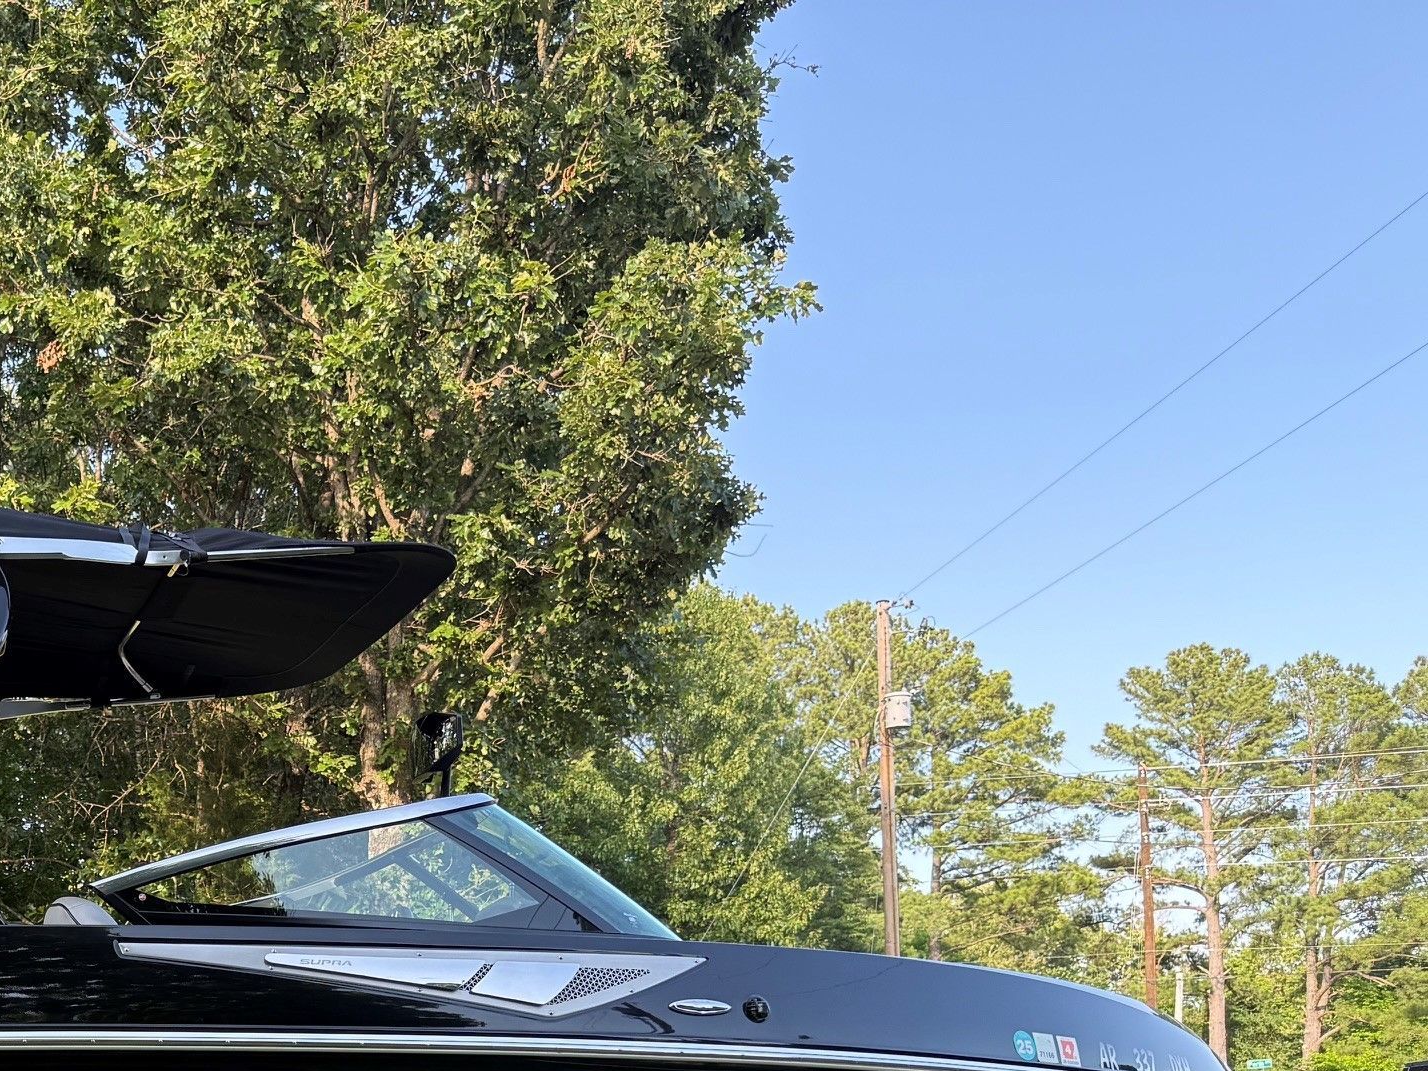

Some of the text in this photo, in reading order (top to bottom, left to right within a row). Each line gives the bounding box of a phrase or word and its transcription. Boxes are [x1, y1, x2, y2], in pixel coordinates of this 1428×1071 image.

[299, 958, 353, 967] SUPRA
[1016, 1039, 1033, 1055] 25
[1099, 1041, 1119, 1071] AR
